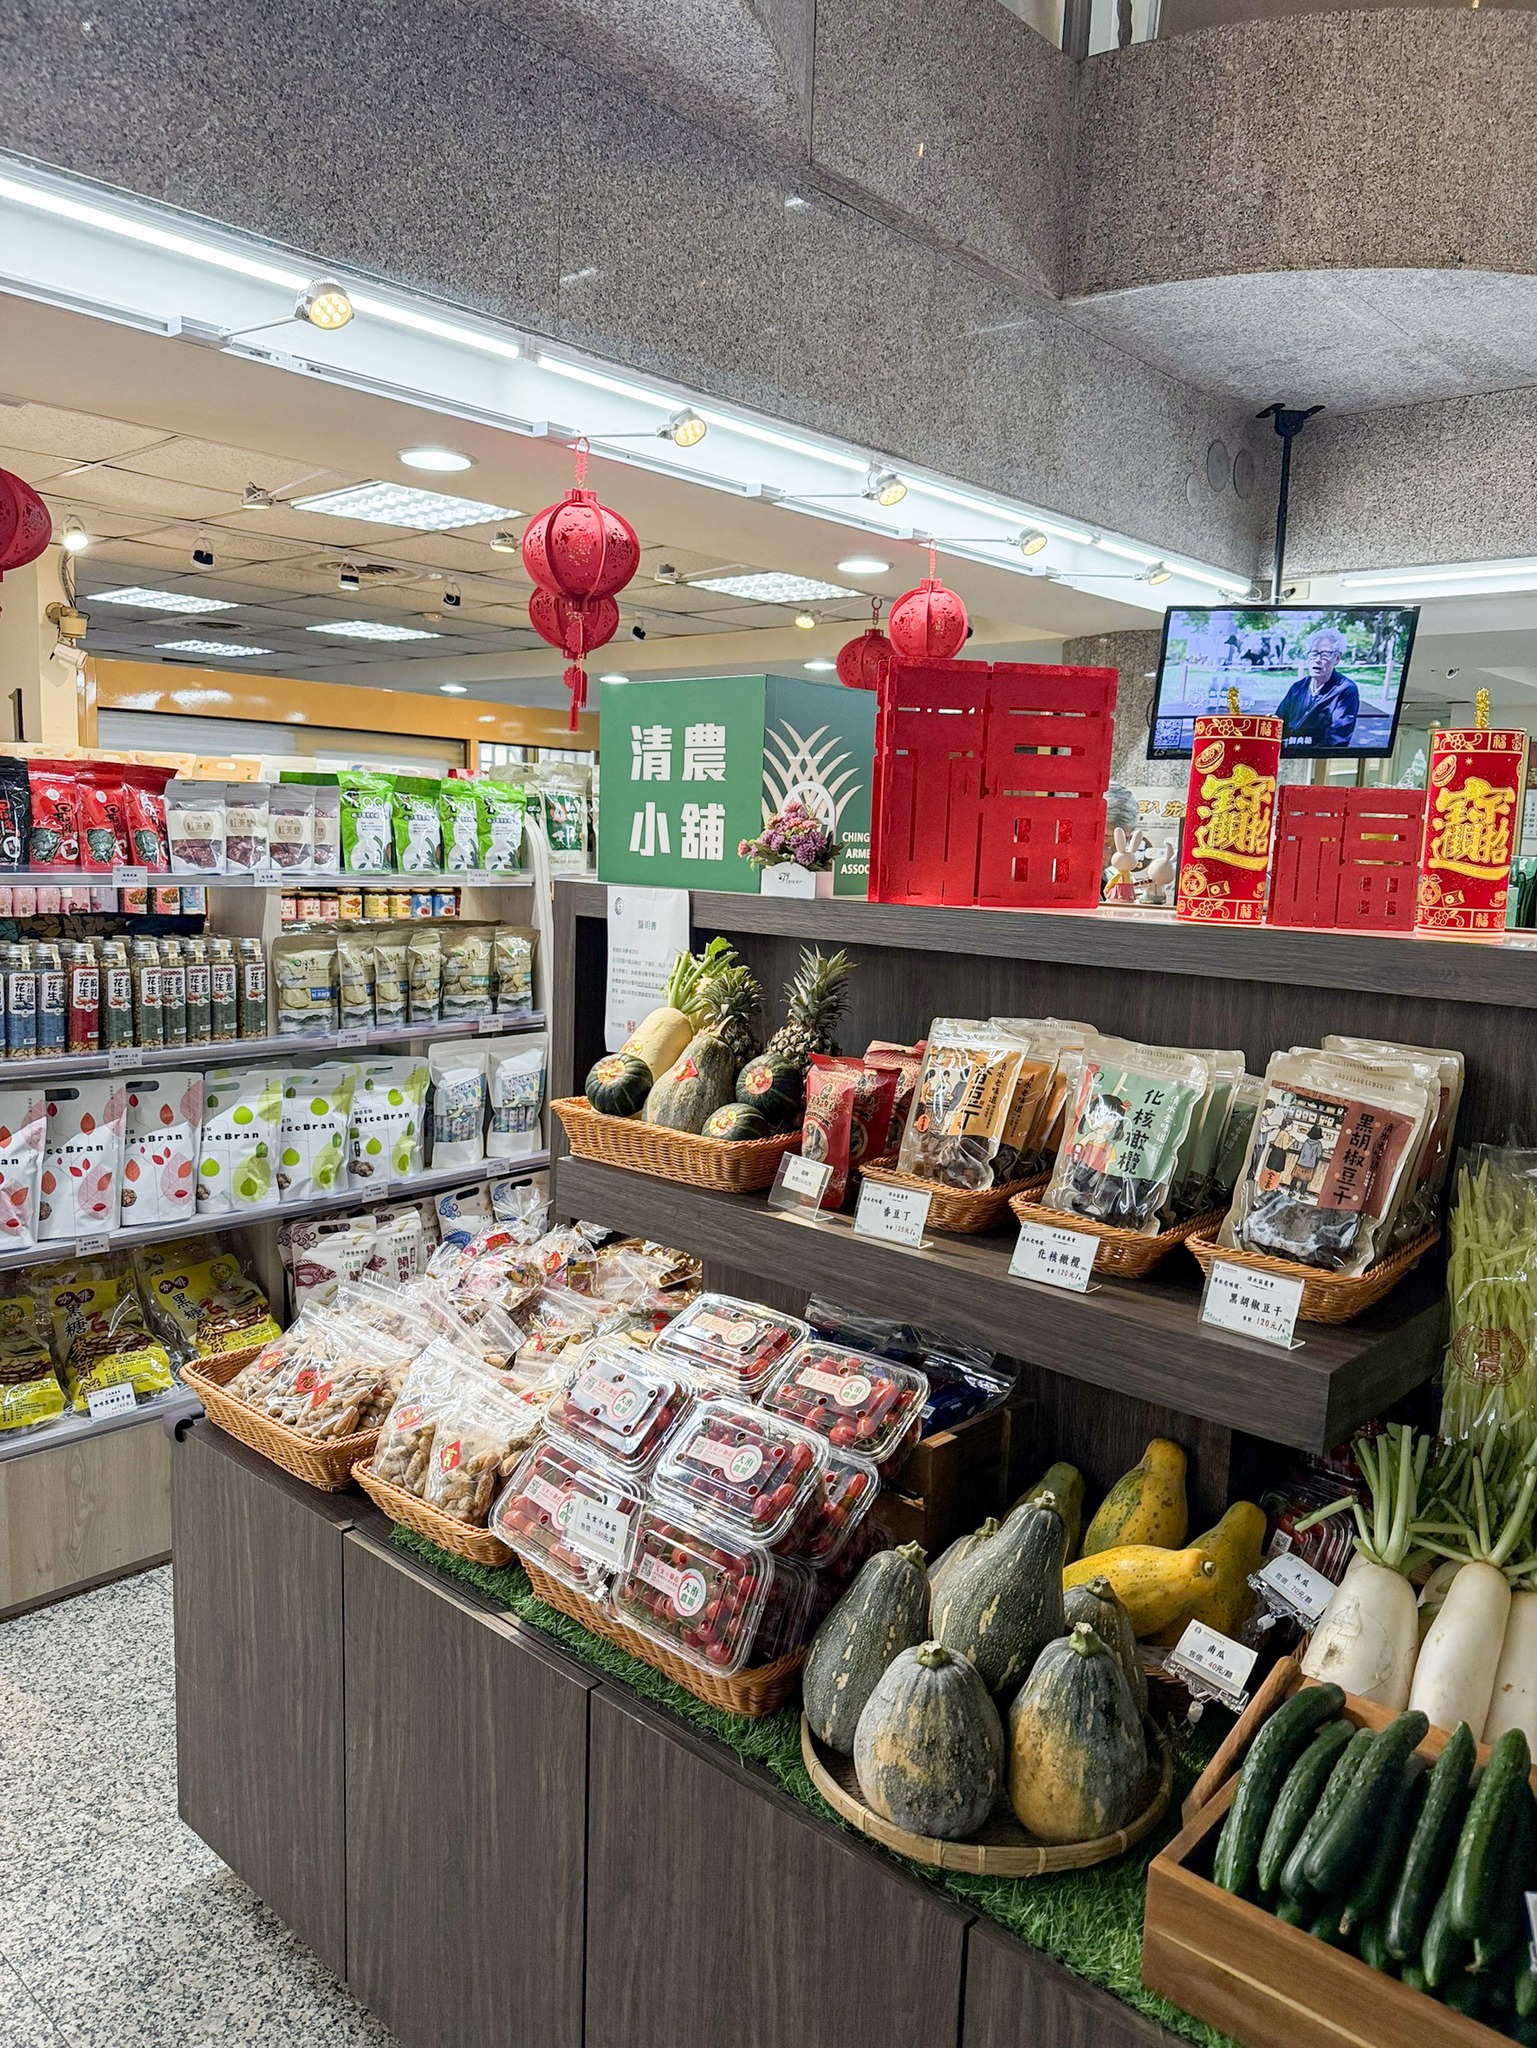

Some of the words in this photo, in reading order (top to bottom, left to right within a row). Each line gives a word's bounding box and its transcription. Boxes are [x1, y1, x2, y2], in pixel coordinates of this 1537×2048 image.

[630, 723, 727, 781] 清農
[629, 801, 726, 861] 小舖
[842, 831, 870, 843] CHING
[47, 981, 58, 1001] 花生
[79, 978, 89, 998] 花生
[113, 978, 124, 998] 花生
[146, 976, 156, 995] 花生
[163, 976, 174, 996] 花生
[190, 974, 200, 993] 花生
[214, 973, 225, 992] 花生
[250, 972, 260, 990] 花生
[14, 982, 26, 1002] 花生
[280, 1121, 336, 1133] iceBran
[354, 1111, 411, 1125] RiceBran
[200, 1131, 260, 1142] iceBran
[1117, 1089, 1166, 1176] 化核橄欖
[1333, 1112, 1377, 1206] 黑胡椒豆干
[56, 1288, 95, 1307] 咖啡
[171, 1292, 206, 1321] 黑糖
[1229, 1292, 1283, 1317] 黑胡椒豆干
[64, 1303, 88, 1338] 黑糖
[1207, 1644, 1226, 1660] 南瓜
